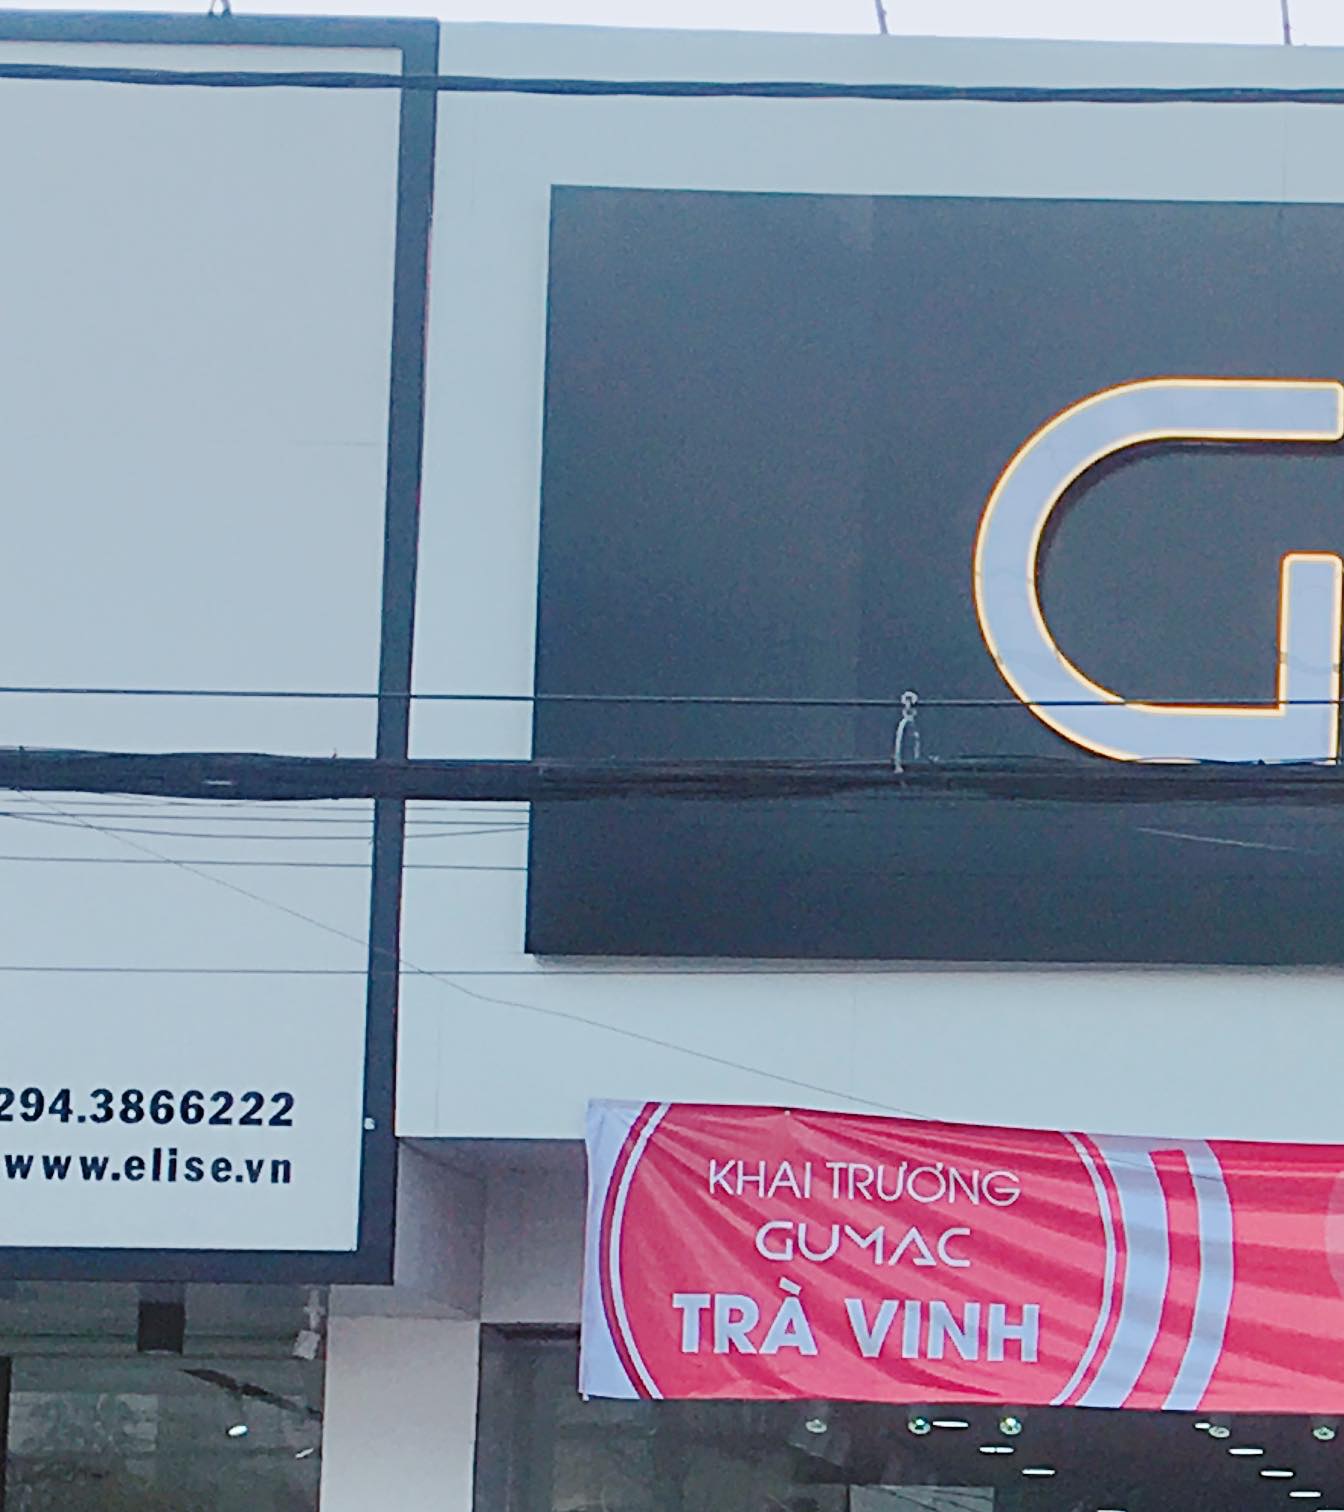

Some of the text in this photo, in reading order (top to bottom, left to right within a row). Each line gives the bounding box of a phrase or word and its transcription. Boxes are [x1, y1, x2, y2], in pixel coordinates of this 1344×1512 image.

[4, 1147, 292, 1184] www.elise.vn
[708, 1159, 1022, 1207] KHAI TRƯƠNG
[755, 1221, 971, 1267] GUMAC
[671, 1276, 1041, 1363] TRÀ VINH
